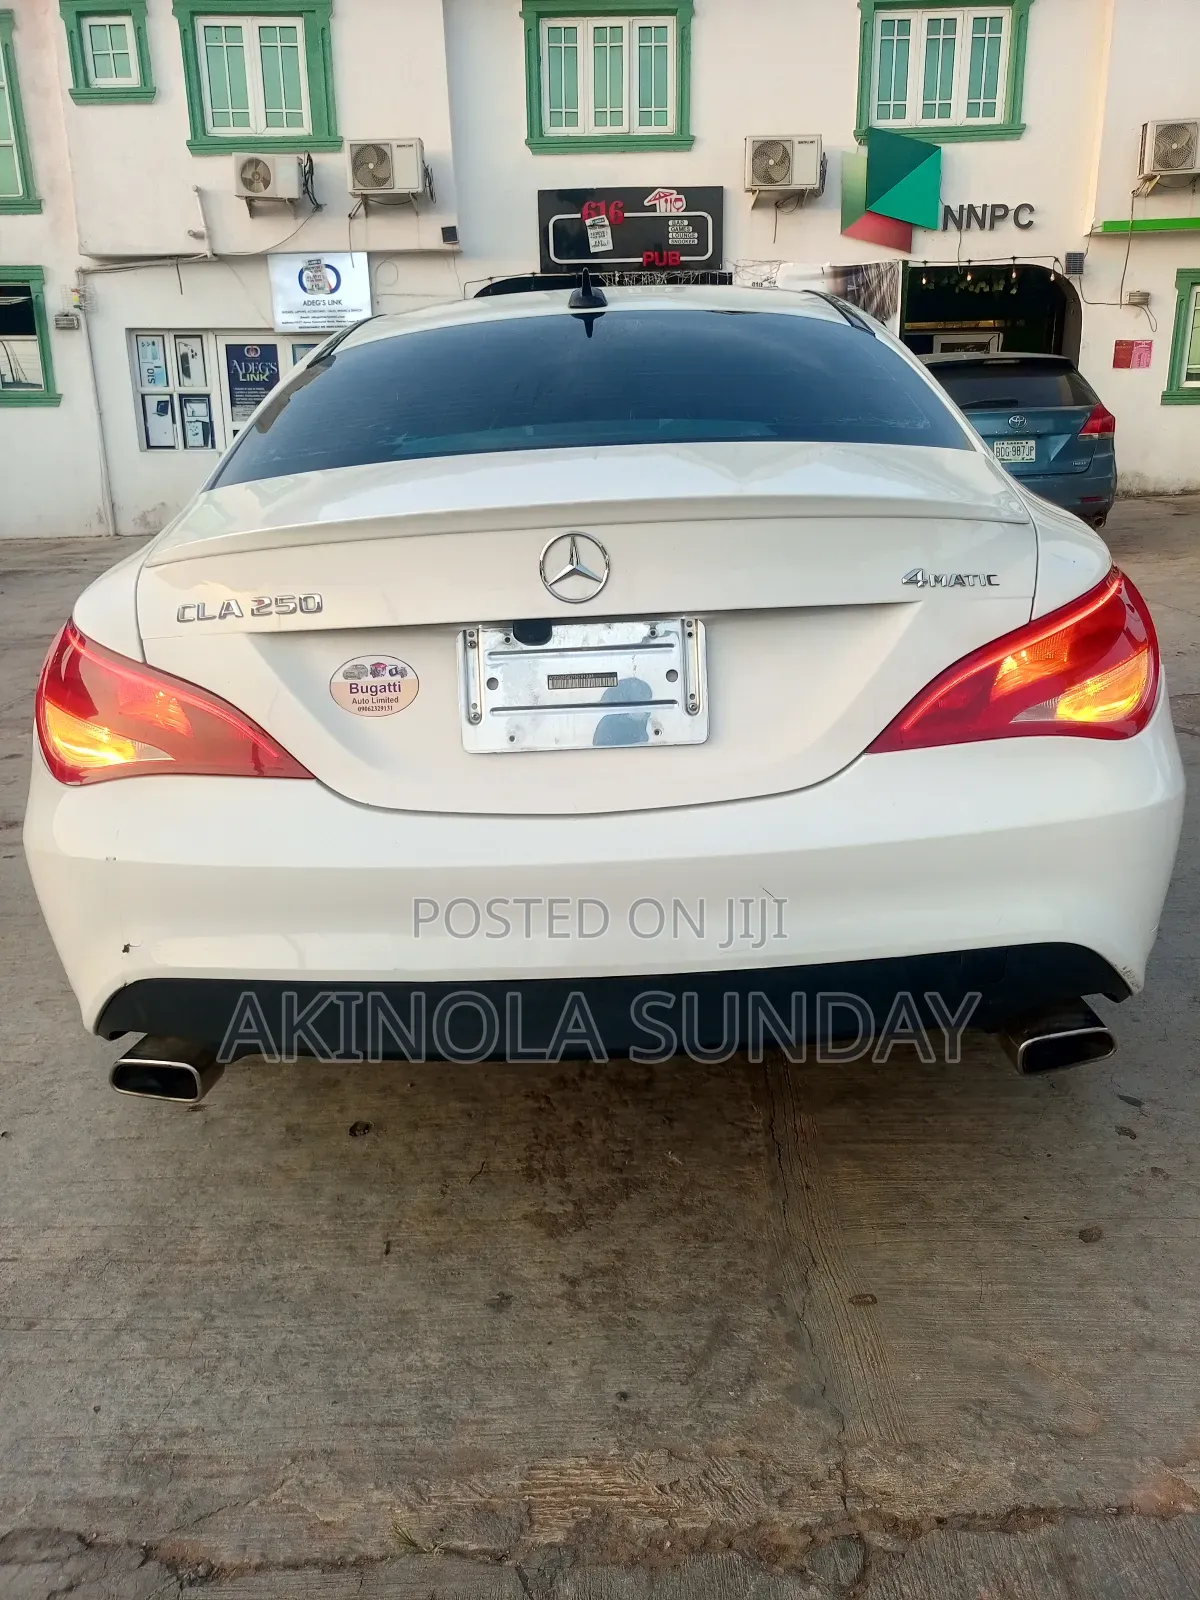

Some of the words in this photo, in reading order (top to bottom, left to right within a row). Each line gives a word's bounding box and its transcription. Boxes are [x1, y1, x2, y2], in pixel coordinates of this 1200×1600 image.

[582, 200, 625, 225] 616
[941, 203, 1035, 231] NNPC
[643, 251, 681, 267] PUB
[231, 360, 278, 374] ADEG'S
[240, 372, 269, 382] LINK
[901, 567, 1000, 588] 4MATIC
[176, 599, 244, 623] CLA
[250, 592, 323, 617] 250
[349, 681, 402, 696] Bugatti
[352, 697, 370, 705] Auto
[371, 696, 399, 704] Limited
